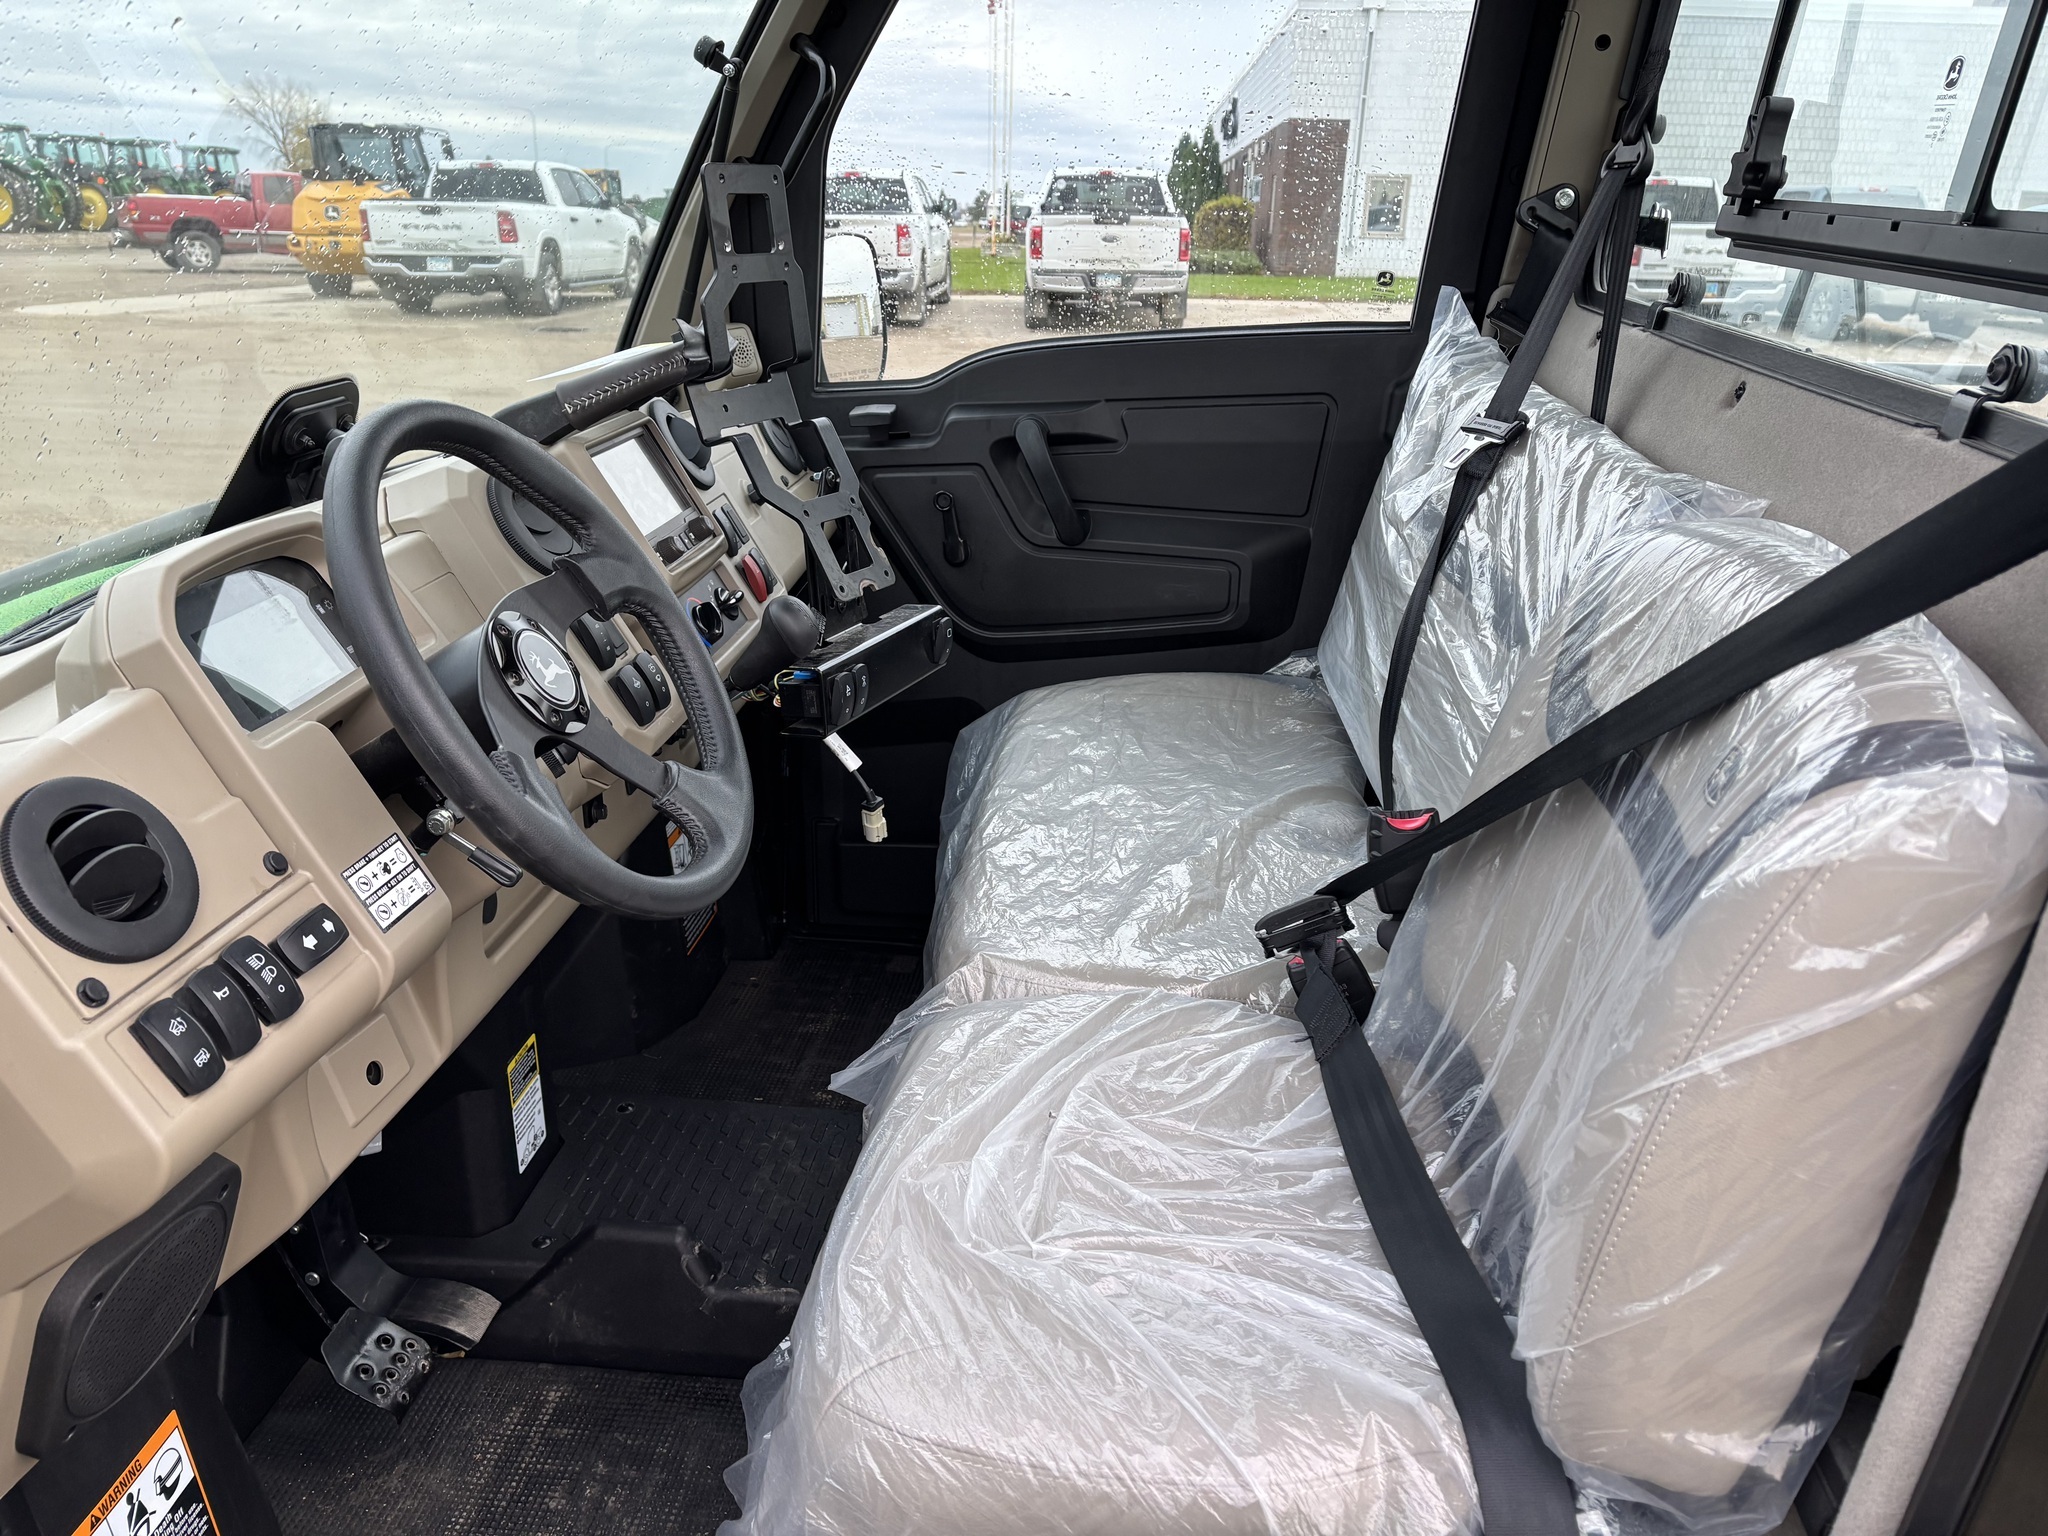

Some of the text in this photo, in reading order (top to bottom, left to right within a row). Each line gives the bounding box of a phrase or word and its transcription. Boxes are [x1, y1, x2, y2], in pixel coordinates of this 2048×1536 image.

[342, 866, 356, 879] PRESS
[354, 858, 367, 871] BRAKE
[376, 844, 385, 853] KEY
[382, 840, 389, 848] TO
[387, 834, 399, 845] START
[365, 892, 378, 906] PRESS
[376, 884, 389, 897] BRAKE
[390, 877, 398, 886] KEY
[406, 862, 416, 874] SHIFT
[98, 1459, 143, 1516] WARNING
[174, 1506, 184, 1523] Off
